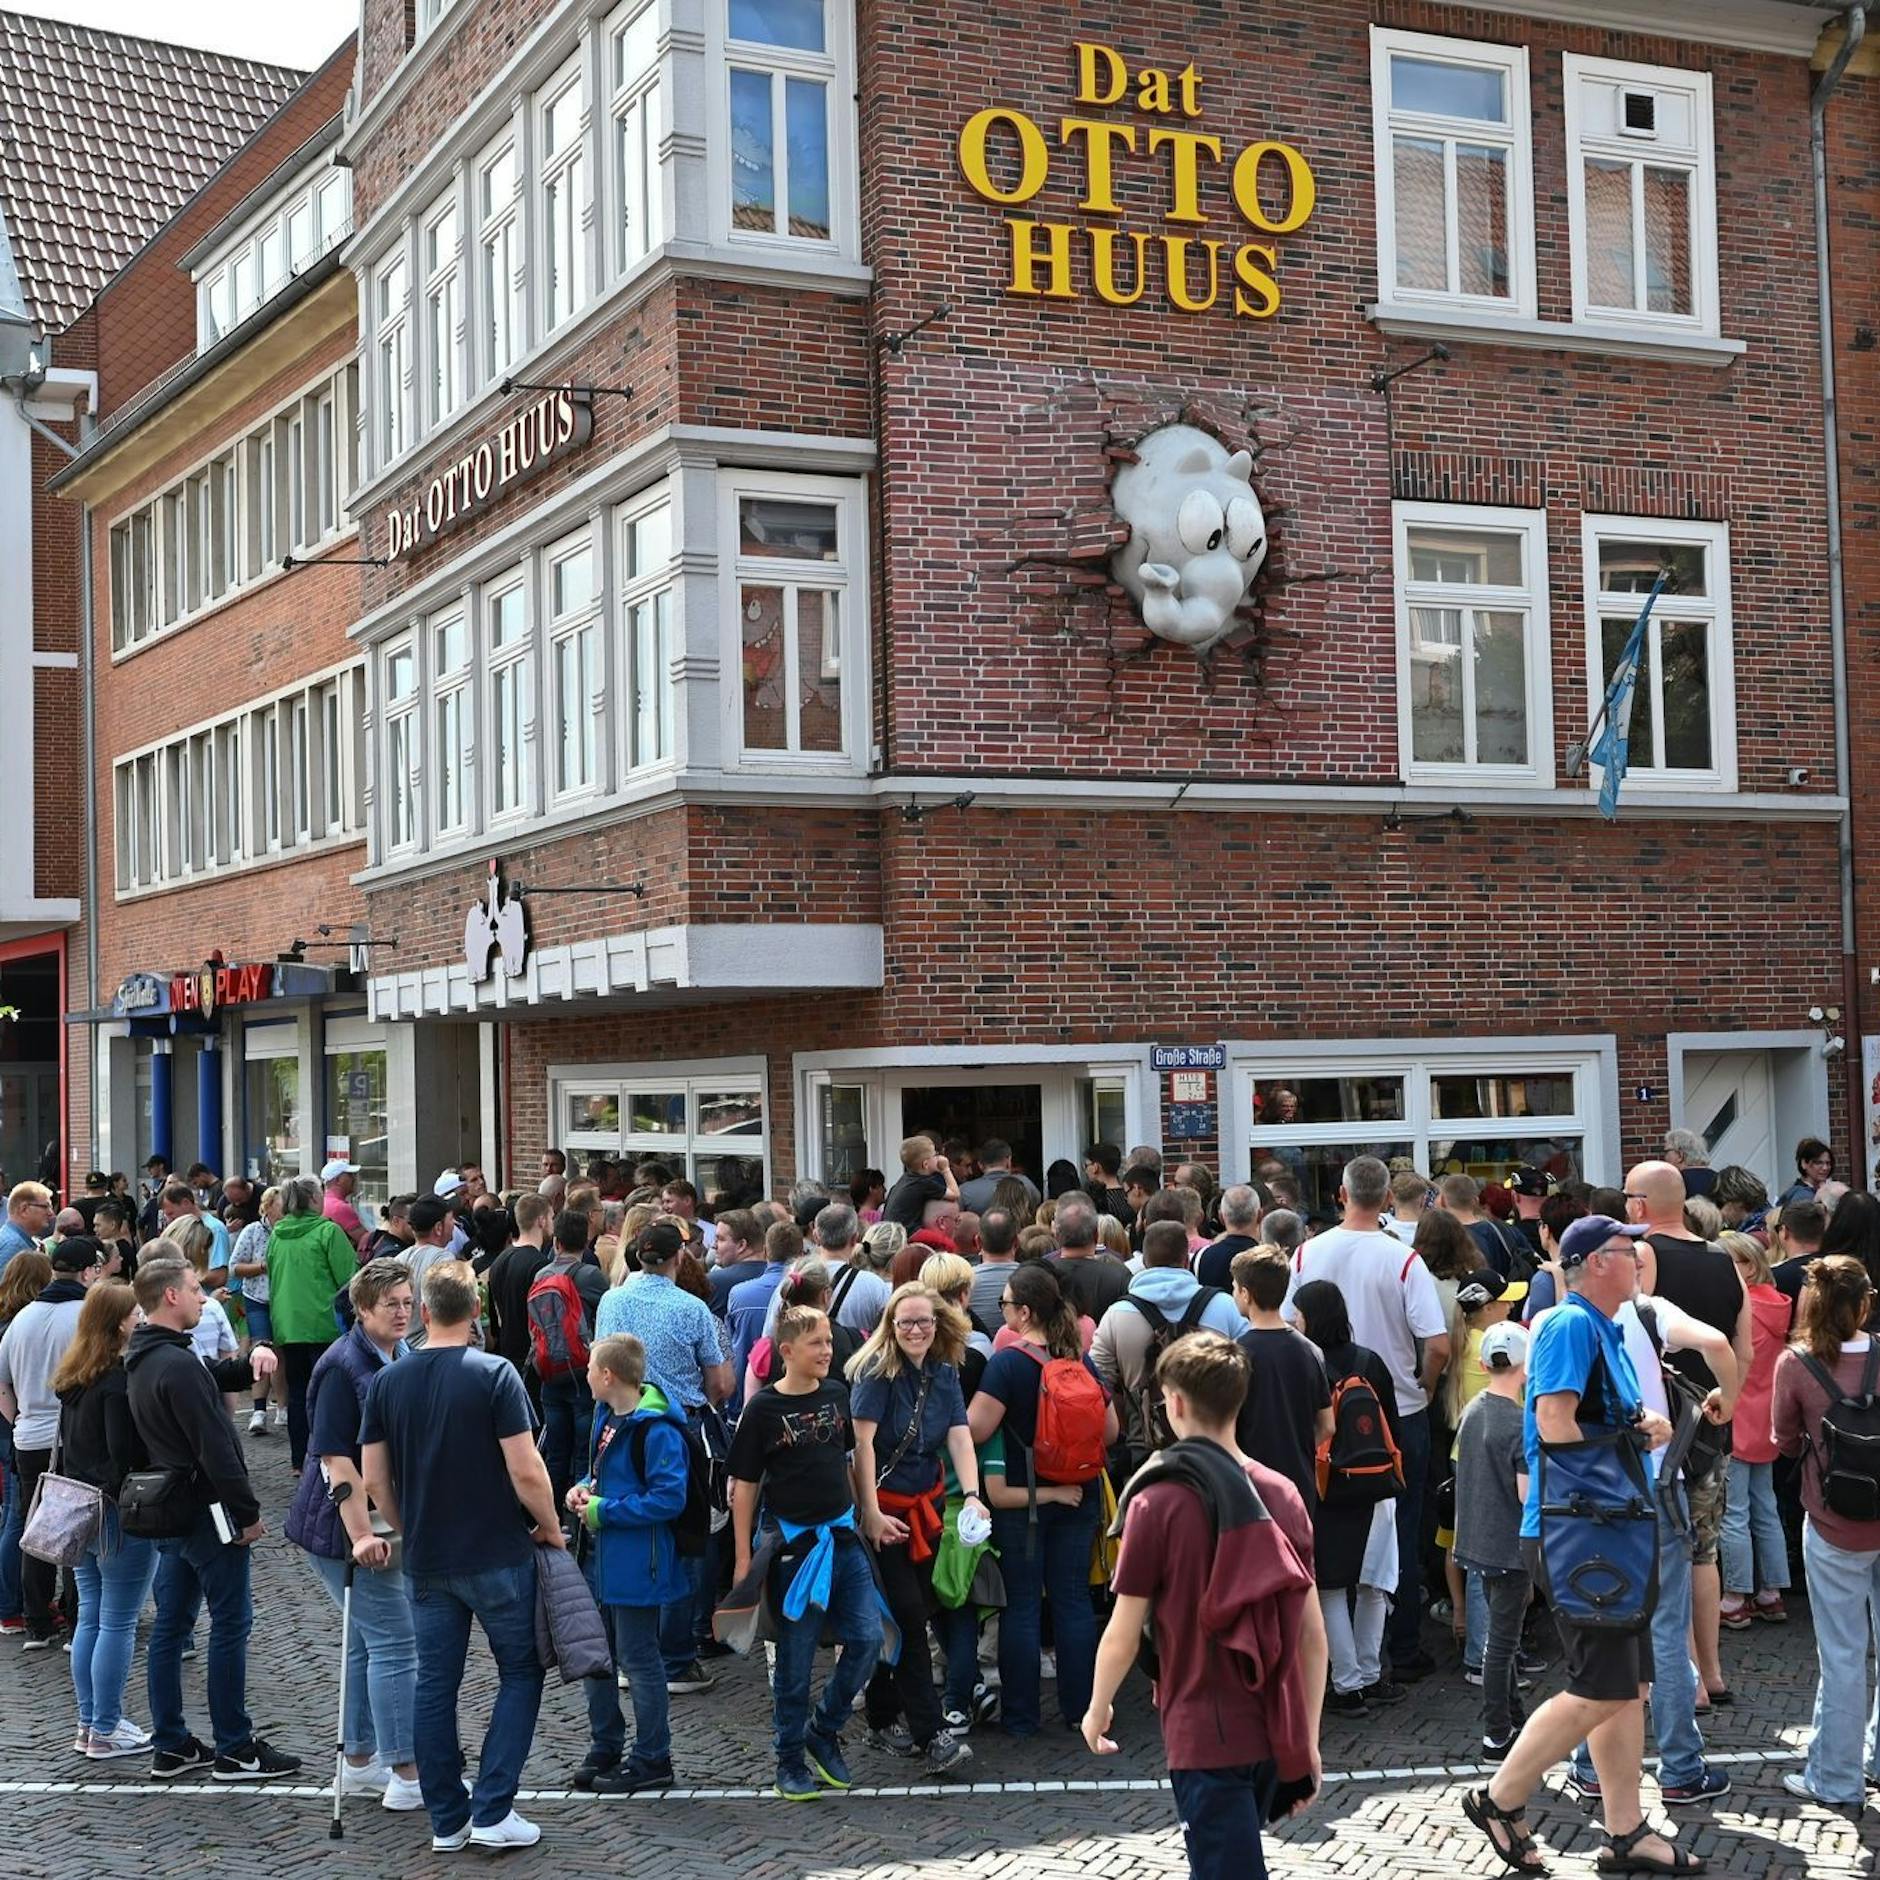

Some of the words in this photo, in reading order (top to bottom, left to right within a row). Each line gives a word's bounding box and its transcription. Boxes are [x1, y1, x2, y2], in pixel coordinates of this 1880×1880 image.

[1073, 42, 1204, 119] Dat
[957, 108, 1316, 235] OTTO
[1003, 219, 1281, 319] HUUS
[387, 502, 421, 562] Dat
[426, 443, 493, 533] OTTO
[498, 381, 575, 487] HUUS
[215, 964, 263, 1006] PLAY
[1155, 1048, 1186, 1067] Große
[1188, 1048, 1222, 1067] Straße
[1640, 1088, 1648, 1101] 1
